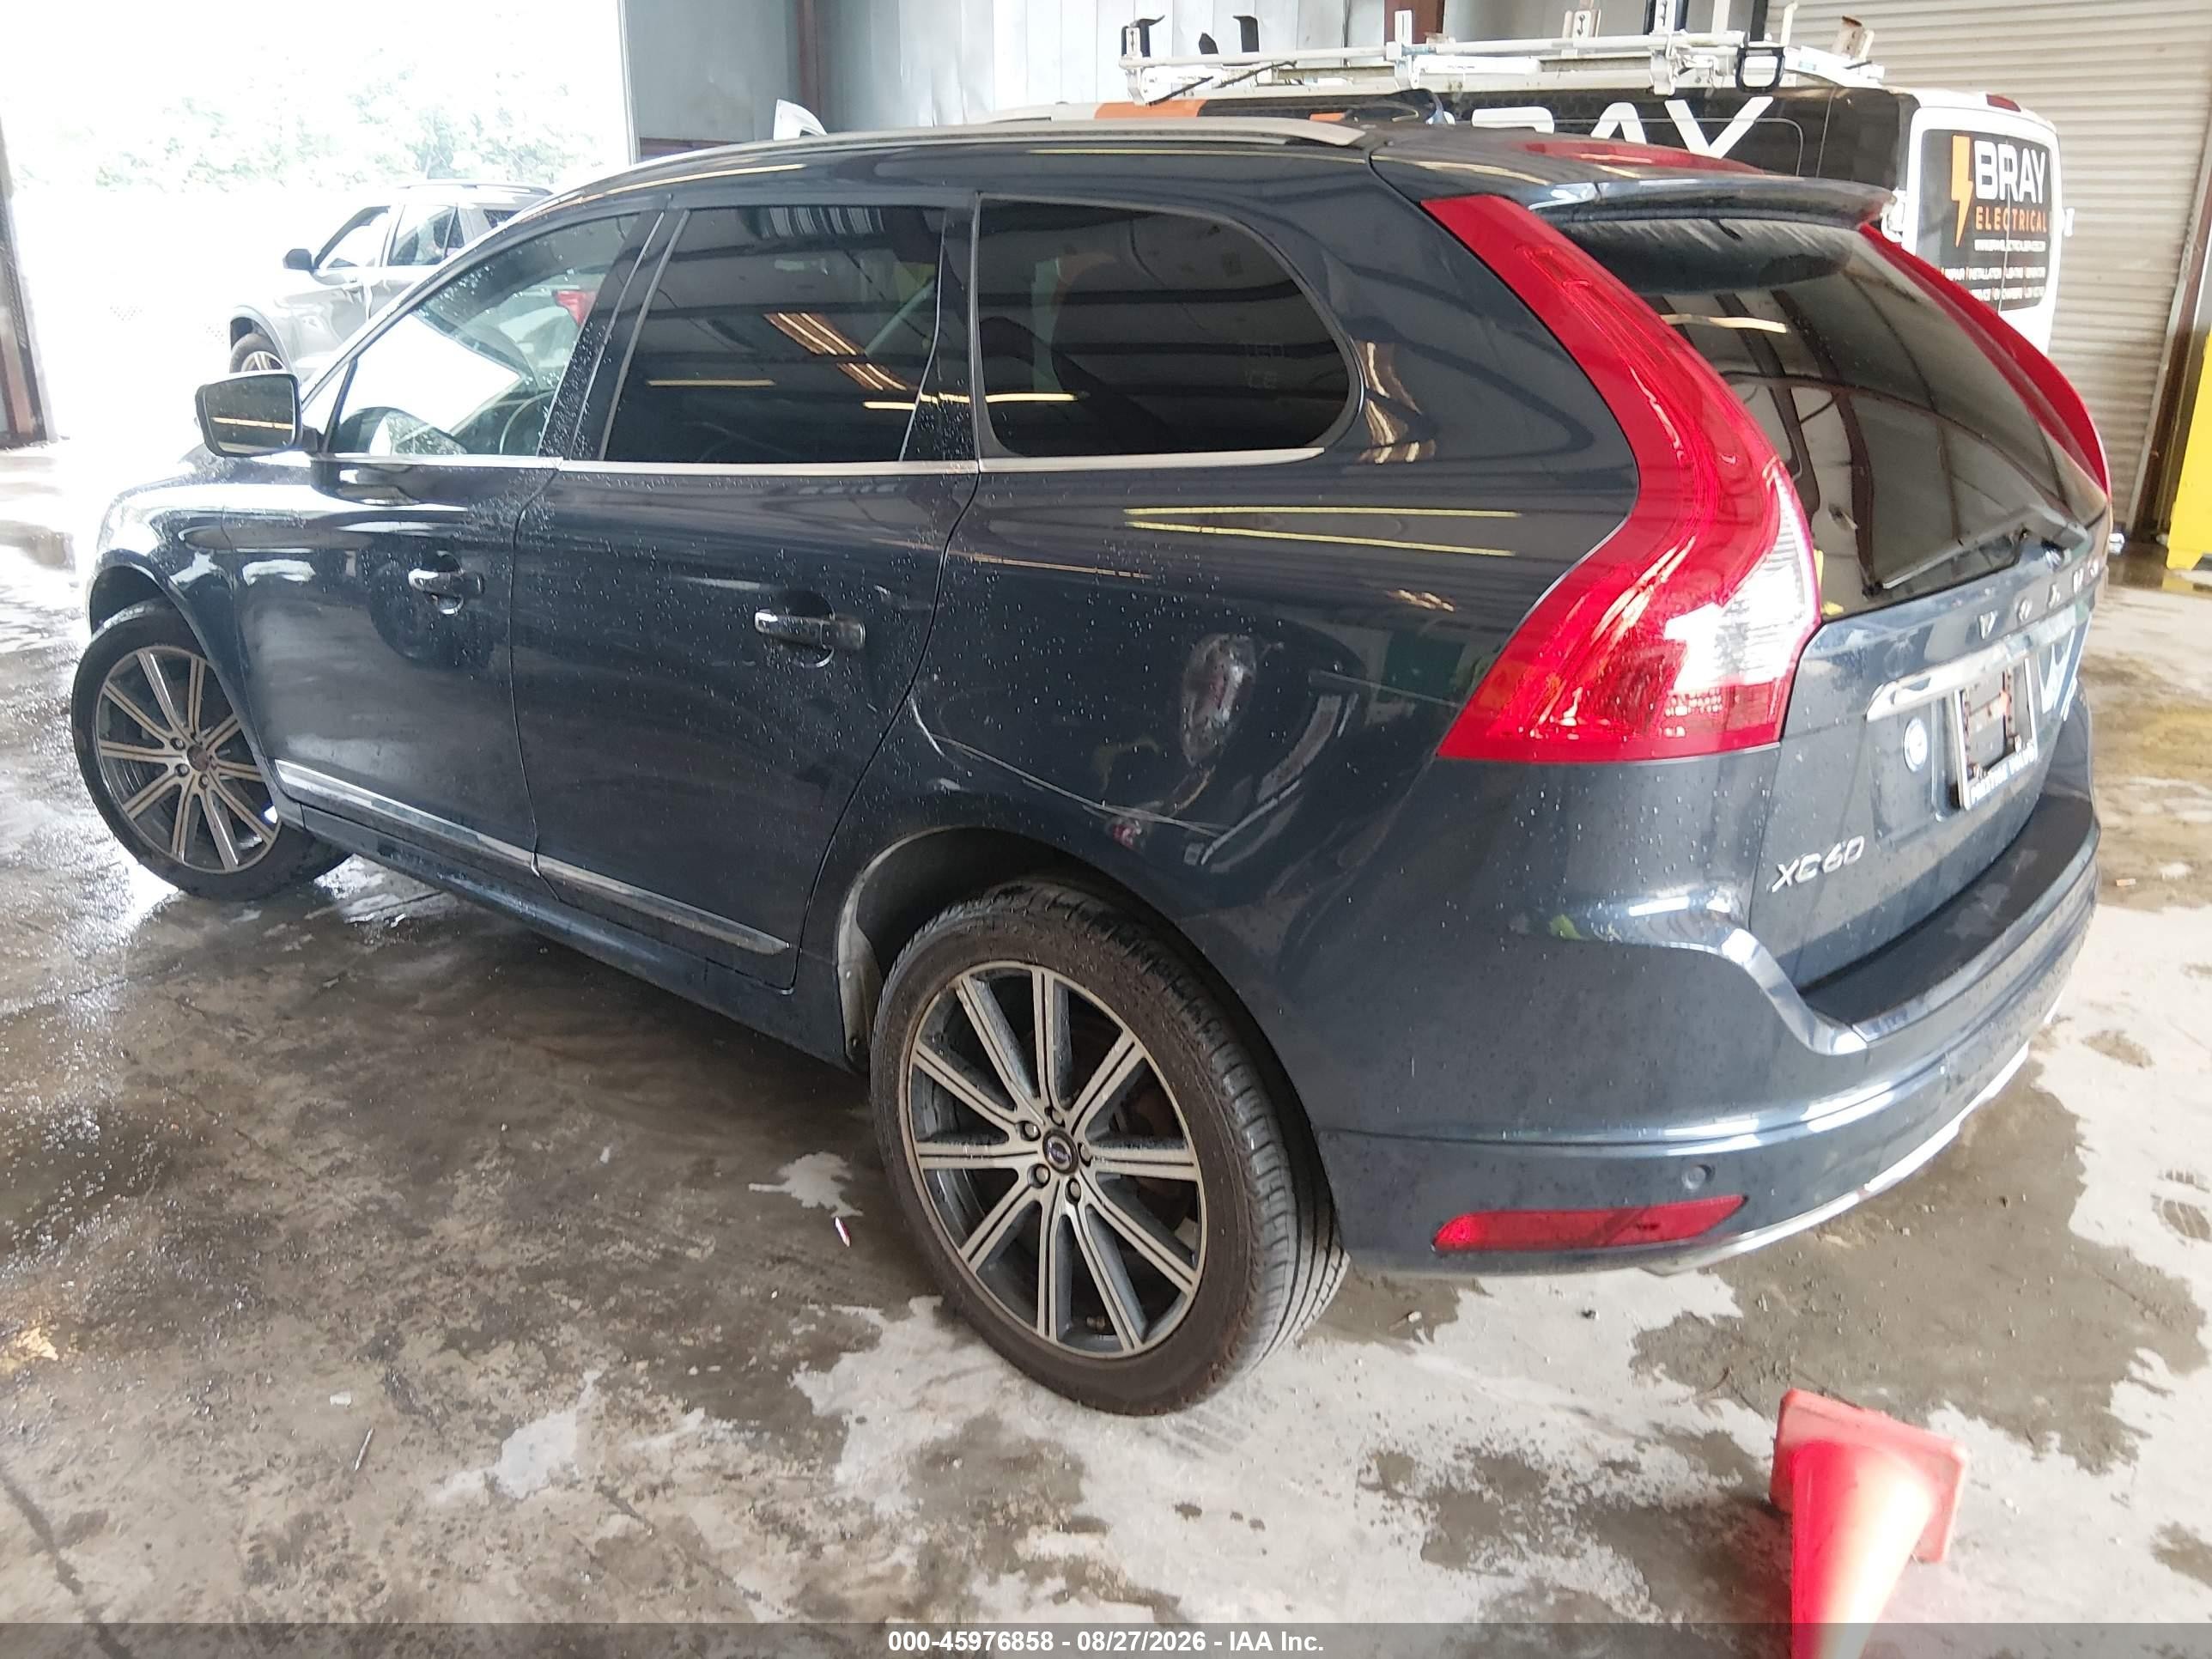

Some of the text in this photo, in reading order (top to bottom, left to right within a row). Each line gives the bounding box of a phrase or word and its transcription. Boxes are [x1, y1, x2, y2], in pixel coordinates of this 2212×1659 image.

[1975, 140, 2045, 204] BRAY
[1976, 206, 2046, 232] ELECTRICAL
[1771, 836, 1864, 892] XC60
